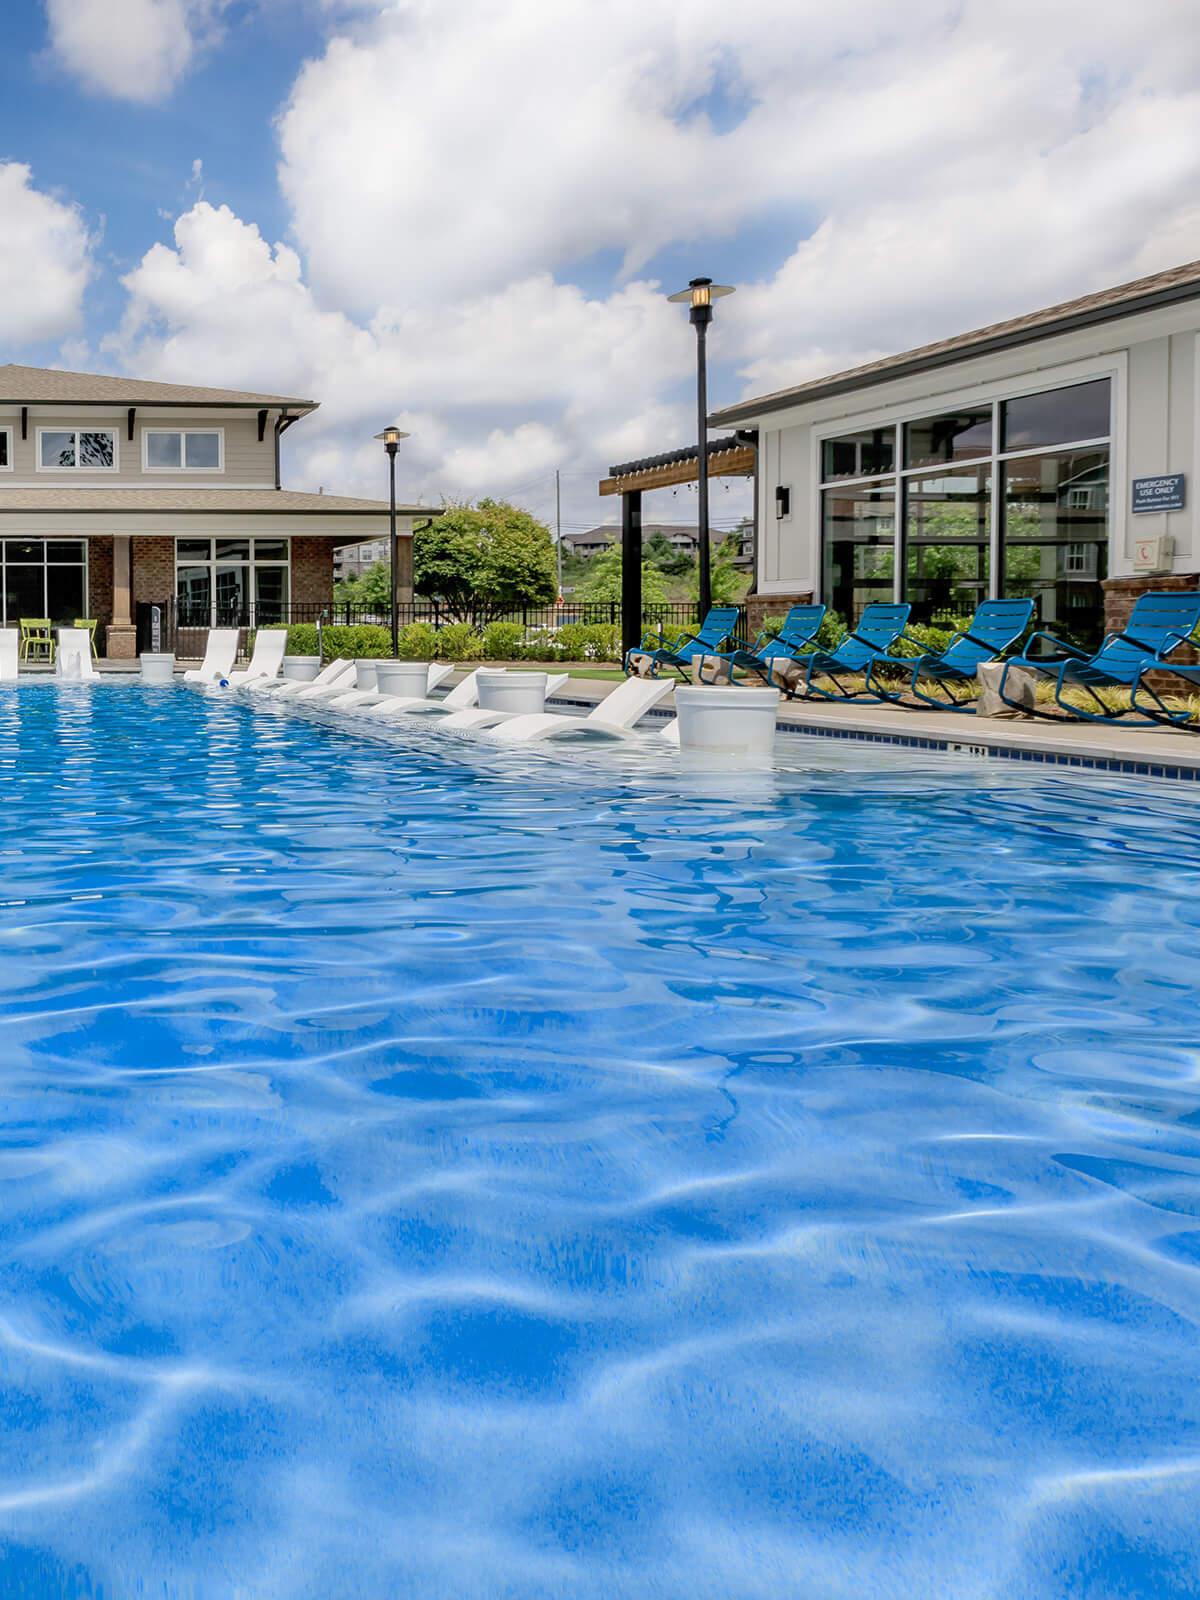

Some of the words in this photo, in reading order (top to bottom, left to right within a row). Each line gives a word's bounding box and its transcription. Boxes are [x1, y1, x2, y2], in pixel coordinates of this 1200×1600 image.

[1135, 478, 1179, 489] EMERGENCY
[1139, 488, 1153, 496] USE
[1154, 487, 1174, 495] ONLY
